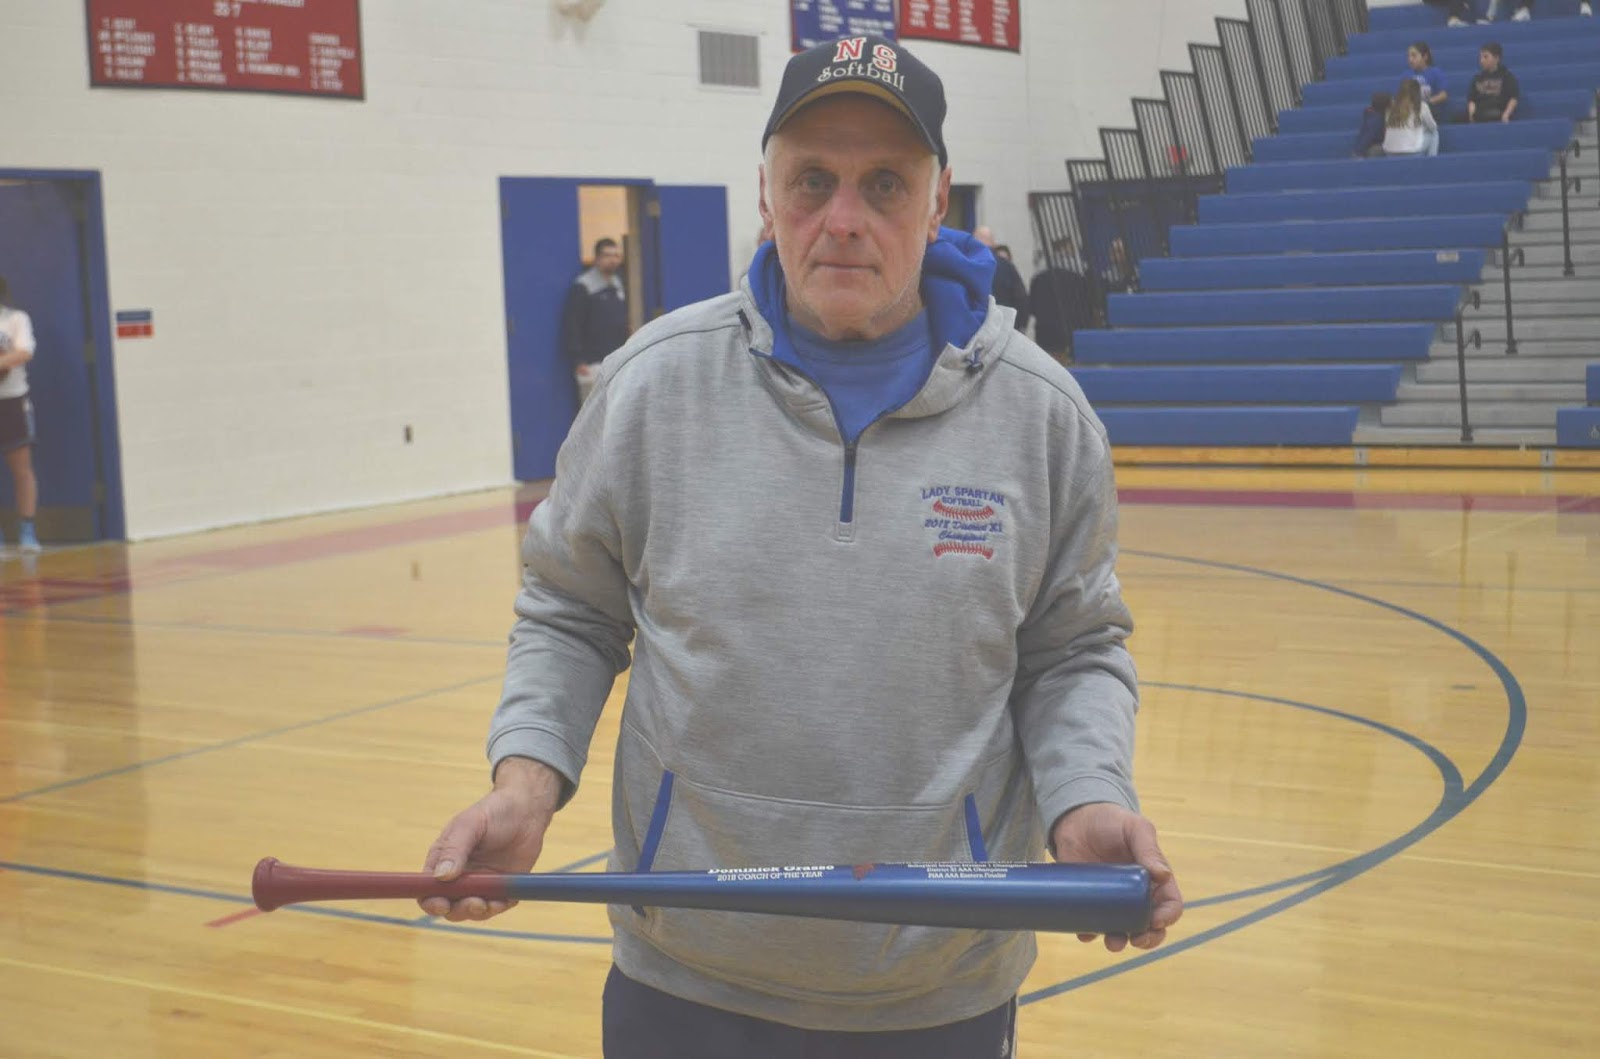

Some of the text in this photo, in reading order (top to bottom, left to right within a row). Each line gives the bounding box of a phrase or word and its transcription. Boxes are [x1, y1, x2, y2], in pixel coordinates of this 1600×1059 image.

[922, 486, 1005, 506] LADY SPARTAN
[941, 496, 982, 507] SOFTBALL
[737, 872, 769, 881] COACH
[769, 872, 781, 880] OF
[781, 871, 800, 879] THE
[800, 870, 823, 878] YEAR
